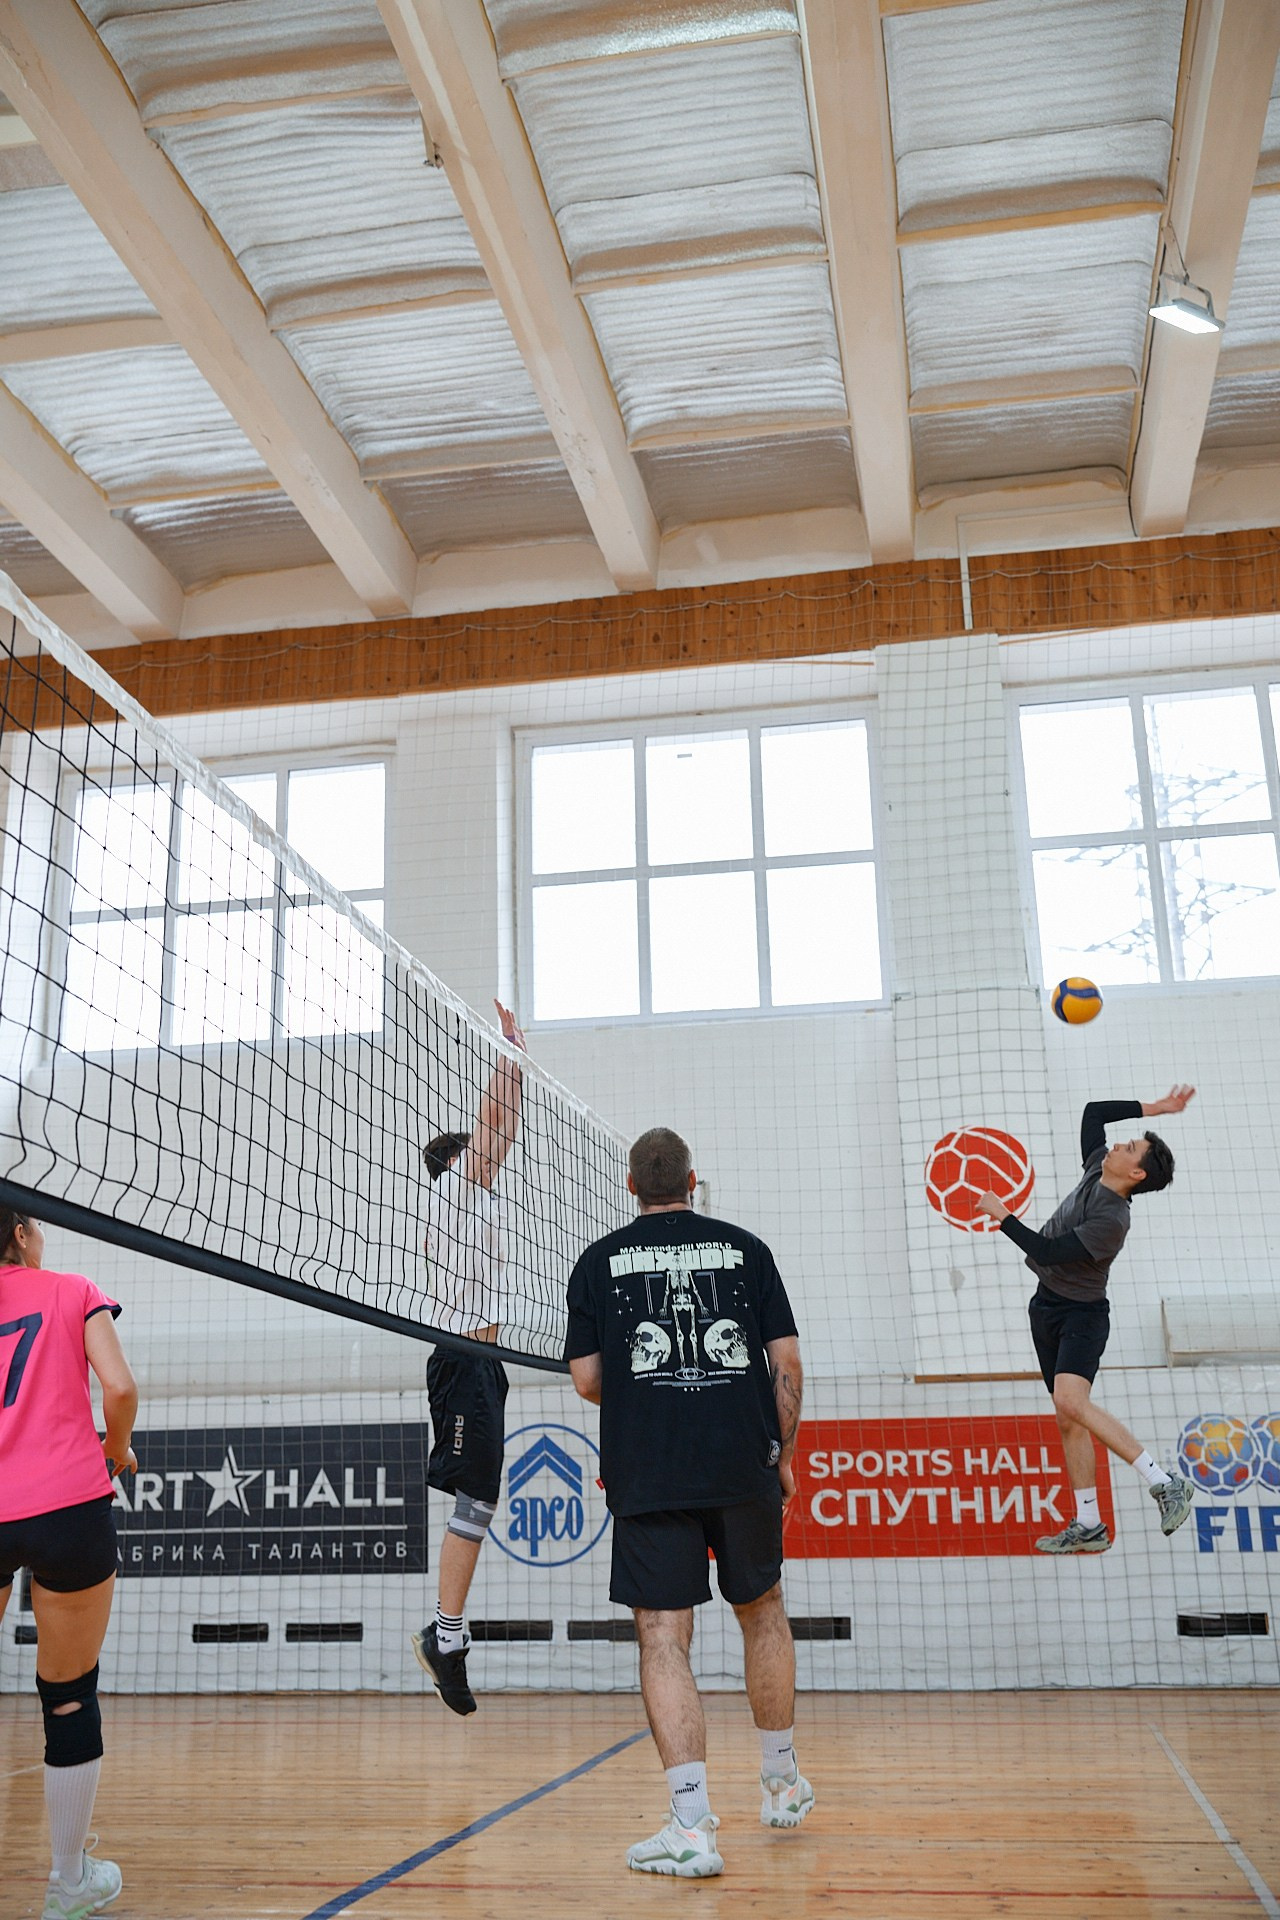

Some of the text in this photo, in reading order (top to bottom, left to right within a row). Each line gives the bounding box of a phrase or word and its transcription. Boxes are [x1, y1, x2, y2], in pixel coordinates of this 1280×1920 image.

[620, 1245, 642, 1255] MAX
[696, 1241, 732, 1250] WORLD
[0, 1311, 43, 1409] 7
[452, 1414, 465, 1456] AND1
[808, 1447, 1061, 1479] SPORTS HALL
[264, 1467, 404, 1509] HALL
[810, 1485, 1065, 1527] СПУТНИК
[248, 1541, 408, 1561] ТАЛАНТОВ
